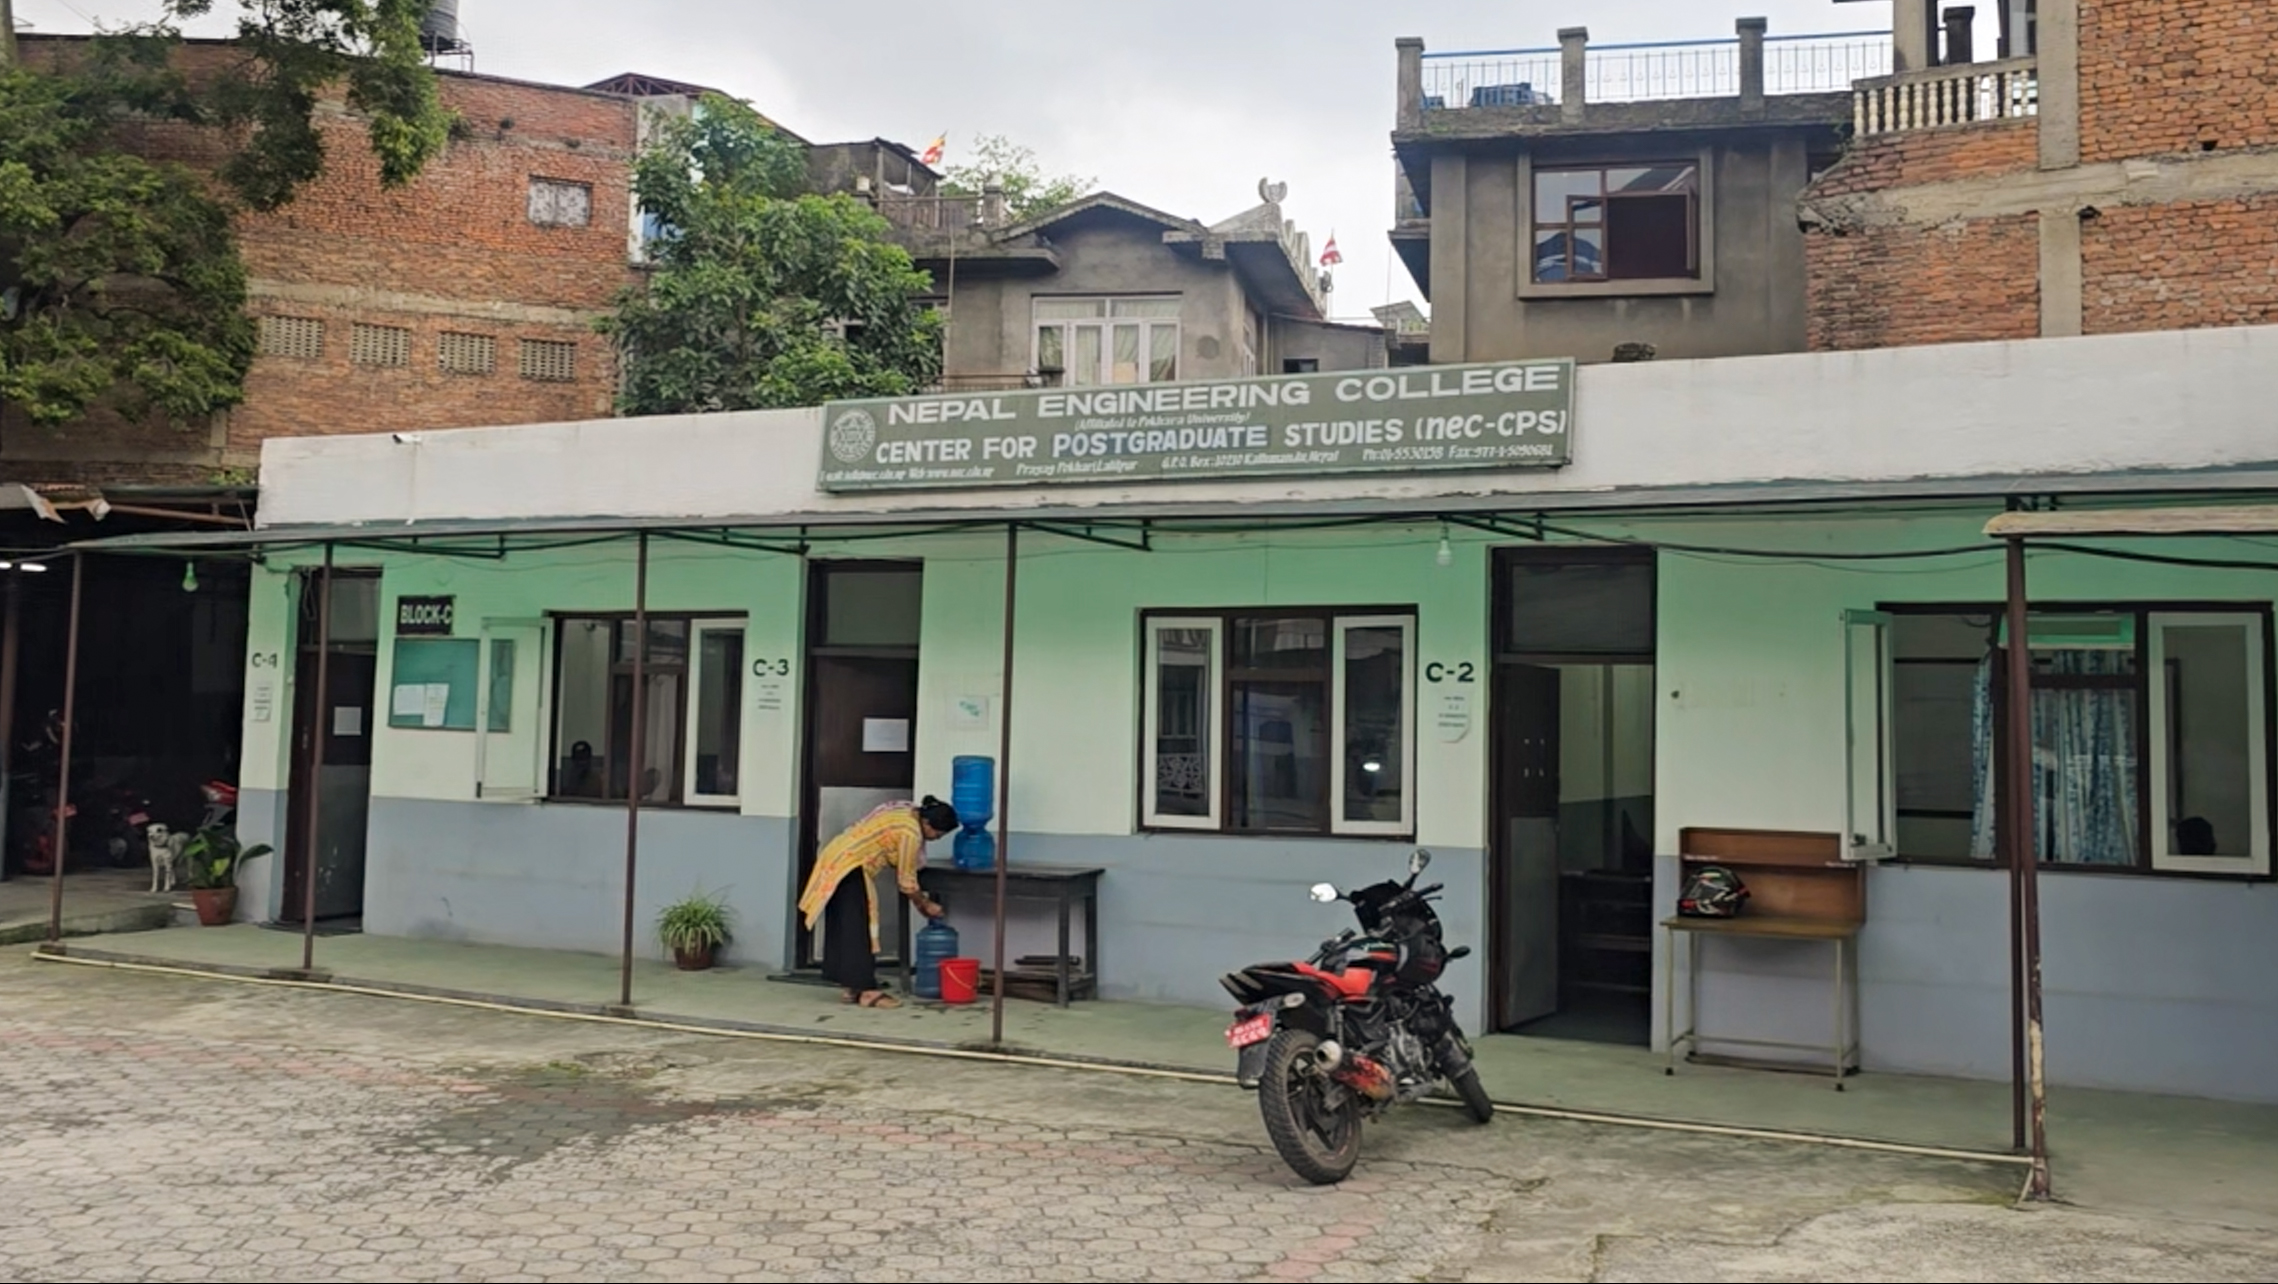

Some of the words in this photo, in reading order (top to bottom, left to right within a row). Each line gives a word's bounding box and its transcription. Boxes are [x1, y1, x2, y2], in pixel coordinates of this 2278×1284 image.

[888, 398, 1016, 425] NEPAL
[1037, 381, 1311, 418] ENGINEERING
[1335, 366, 1560, 402] COLLEGE
[876, 438, 973, 464] CENTER
[983, 436, 1037, 460] FOR
[1052, 425, 1268, 458] POSTGRADUATE
[1284, 419, 1403, 448] STUDIES
[1415, 410, 1566, 440] (nec-CPS)
[400, 603, 453, 625] BLOCK-C
[251, 652, 278, 669] C-4
[752, 658, 789, 677] C-3
[1426, 662, 1475, 683] C-2
